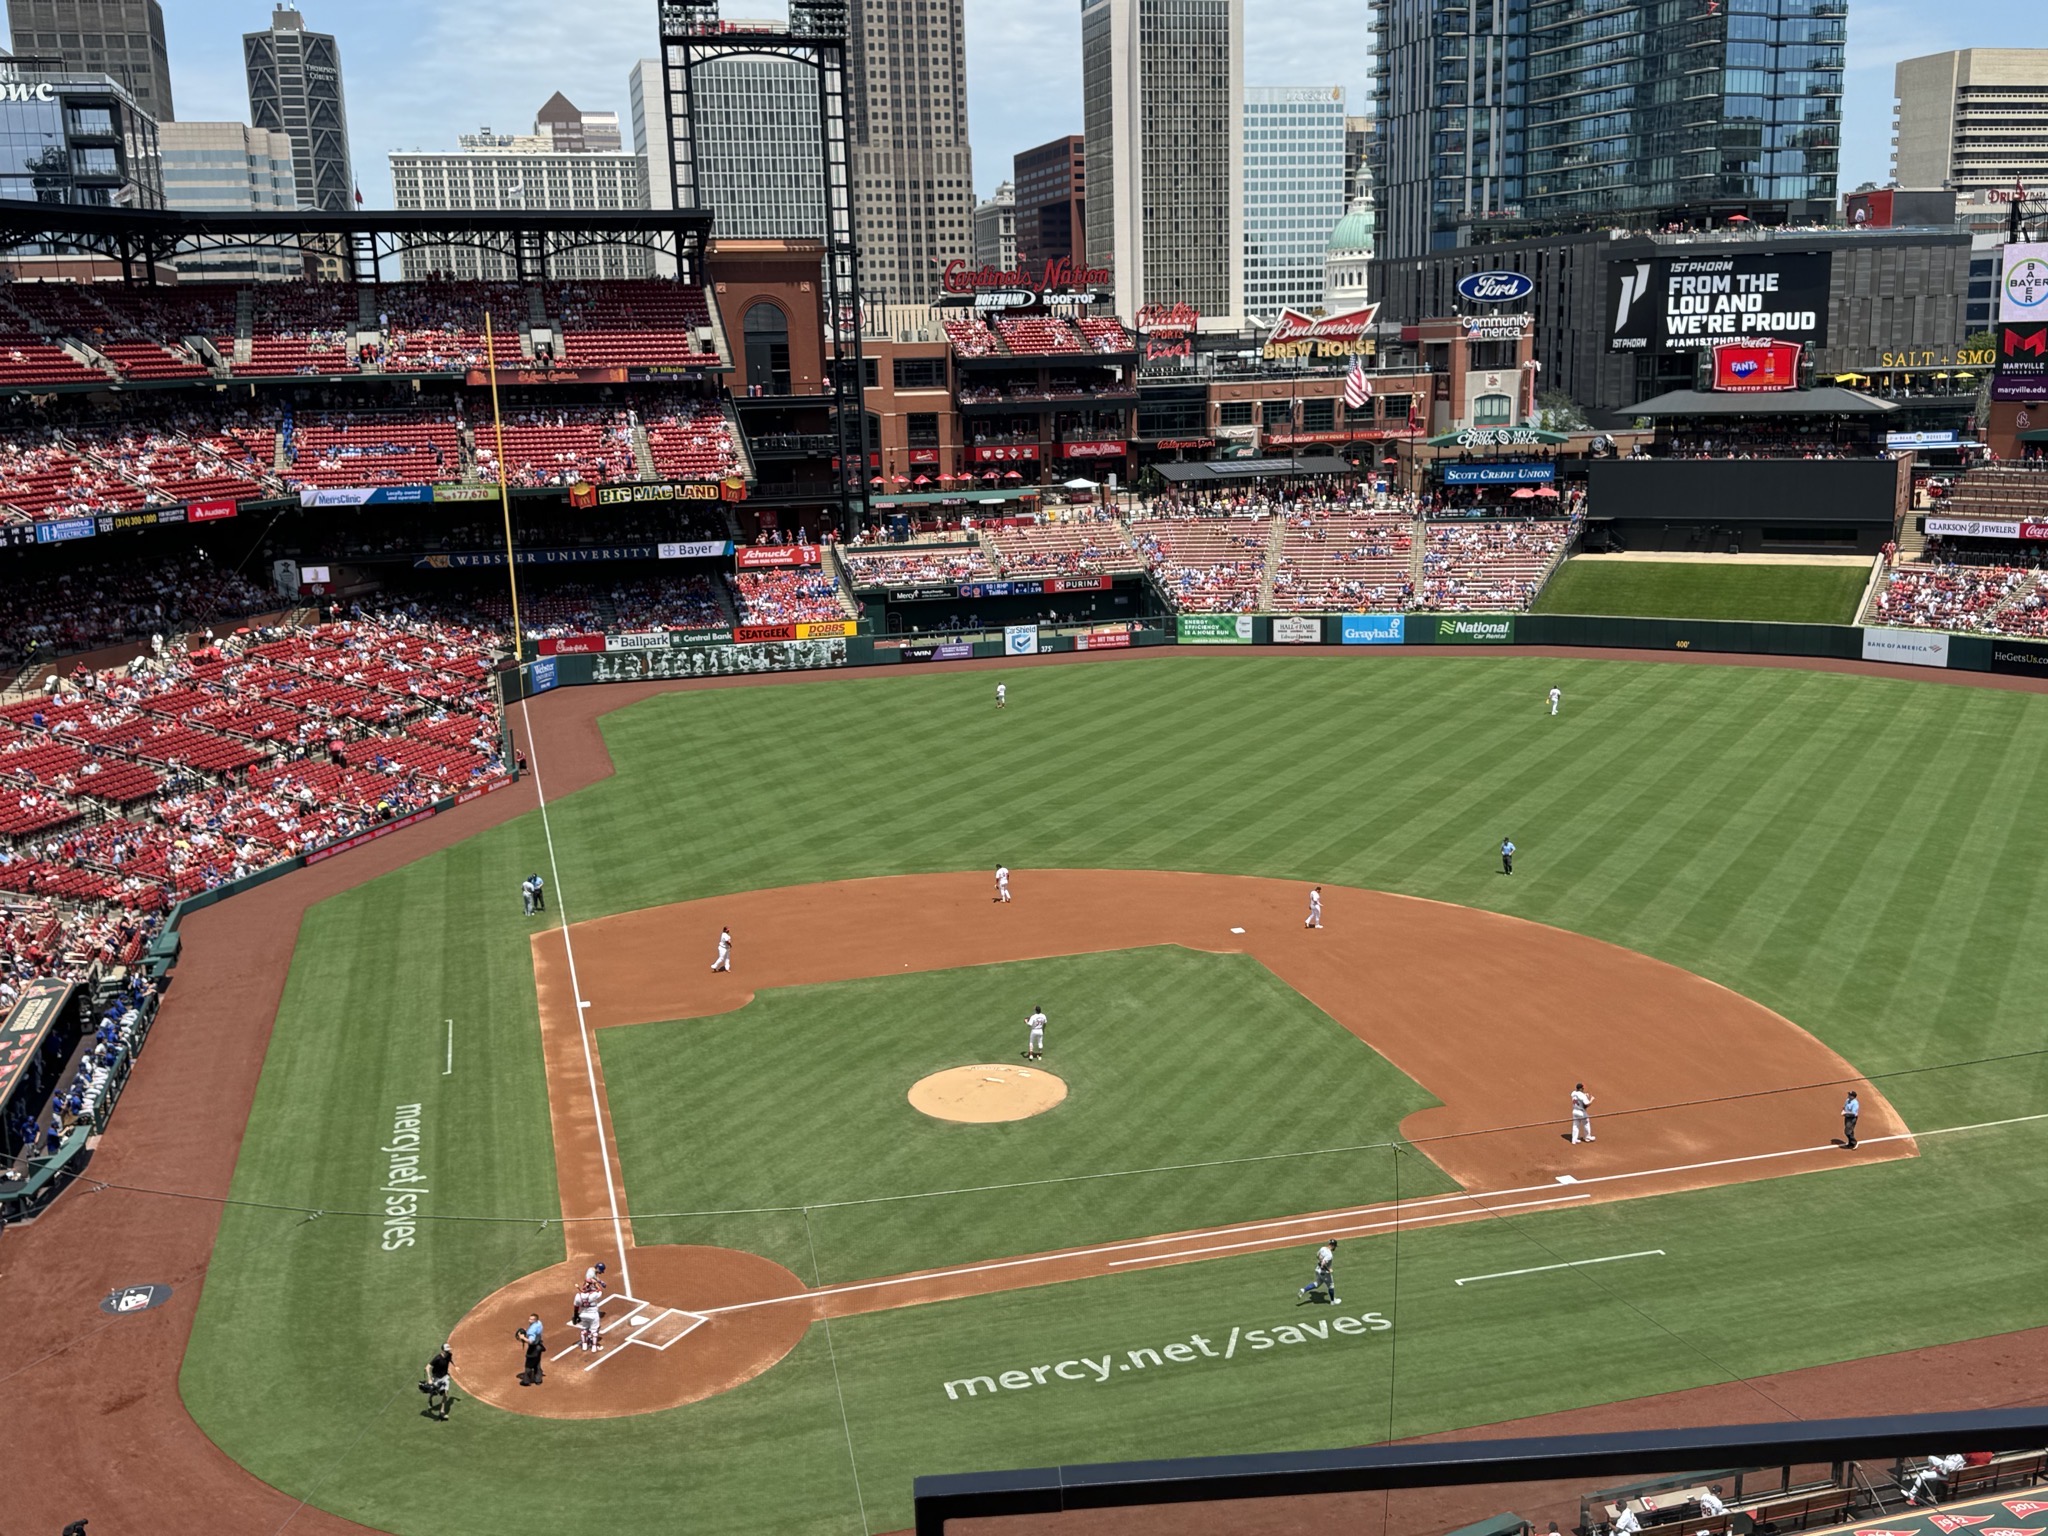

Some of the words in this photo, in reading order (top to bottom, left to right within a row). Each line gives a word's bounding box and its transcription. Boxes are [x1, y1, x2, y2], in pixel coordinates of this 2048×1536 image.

[1988, 189, 2029, 204] DRUY
[1670, 262, 1688, 273] 1ST
[1688, 261, 1733, 272] PHORM
[944, 259, 1032, 293] Cardinals
[1034, 256, 1108, 292] Nation
[1474, 276, 1519, 297] Ford
[1669, 275, 1731, 295] FROM
[1736, 273, 1779, 292] THE
[975, 293, 1025, 306] HOFFMANN
[1043, 295, 1095, 304] ROOFTOP
[1668, 295, 1710, 315] LOU
[1714, 293, 1762, 313] AND
[1463, 315, 1531, 328] Community
[1667, 314, 1736, 334] WE'RE
[1741, 312, 1816, 332] PROUD
[1150, 329, 1184, 339] SPORTS
[1268, 318, 1375, 340] Budweiser
[1146, 339, 1191, 361] Live!
[1264, 342, 1313, 359] BREW
[1317, 340, 1376, 357] HOUSE
[1883, 352, 1934, 367] SALT
[1731, 361, 1758, 372] FANTA
[1997, 386, 2046, 395] maryville.edu
[1513, 437, 1540, 445] DECK
[1448, 470, 1479, 480] SCOTT
[1480, 470, 1516, 479] CREDIT
[1518, 469, 1551, 478] UNION
[600, 488, 632, 505] BIG
[633, 485, 673, 502] MAC
[675, 485, 719, 500] LAND
[204, 508, 230, 517] Audacy
[99, 523, 114, 533] TEXT
[1929, 522, 1968, 532] CLARKSON
[1981, 526, 2017, 534] JEWELERS
[679, 542, 713, 556] Bayer
[743, 549, 795, 559] Schnucks
[457, 552, 536, 566] WEBSTER
[546, 547, 651, 562] UNIVERSITY
[804, 551, 816, 562] 93
[1065, 579, 1099, 589] PURINA
[897, 592, 914, 600] Mercy
[739, 627, 790, 641] SEATGEEK
[809, 623, 846, 633] DOBBS
[1005, 625, 1037, 635] CarShield
[1455, 621, 1509, 634] National
[620, 633, 669, 649] Ballpark
[683, 633, 710, 643] Central
[712, 631, 732, 641] Bank
[1896, 644, 1928, 652] AMERICA
[533, 662, 554, 675] Webster
[380, 1103, 429, 1251] mercy.net/saves
[944, 1311, 1392, 1401] mercy.net/saves
[2010, 1502, 2040, 1513] 2011
